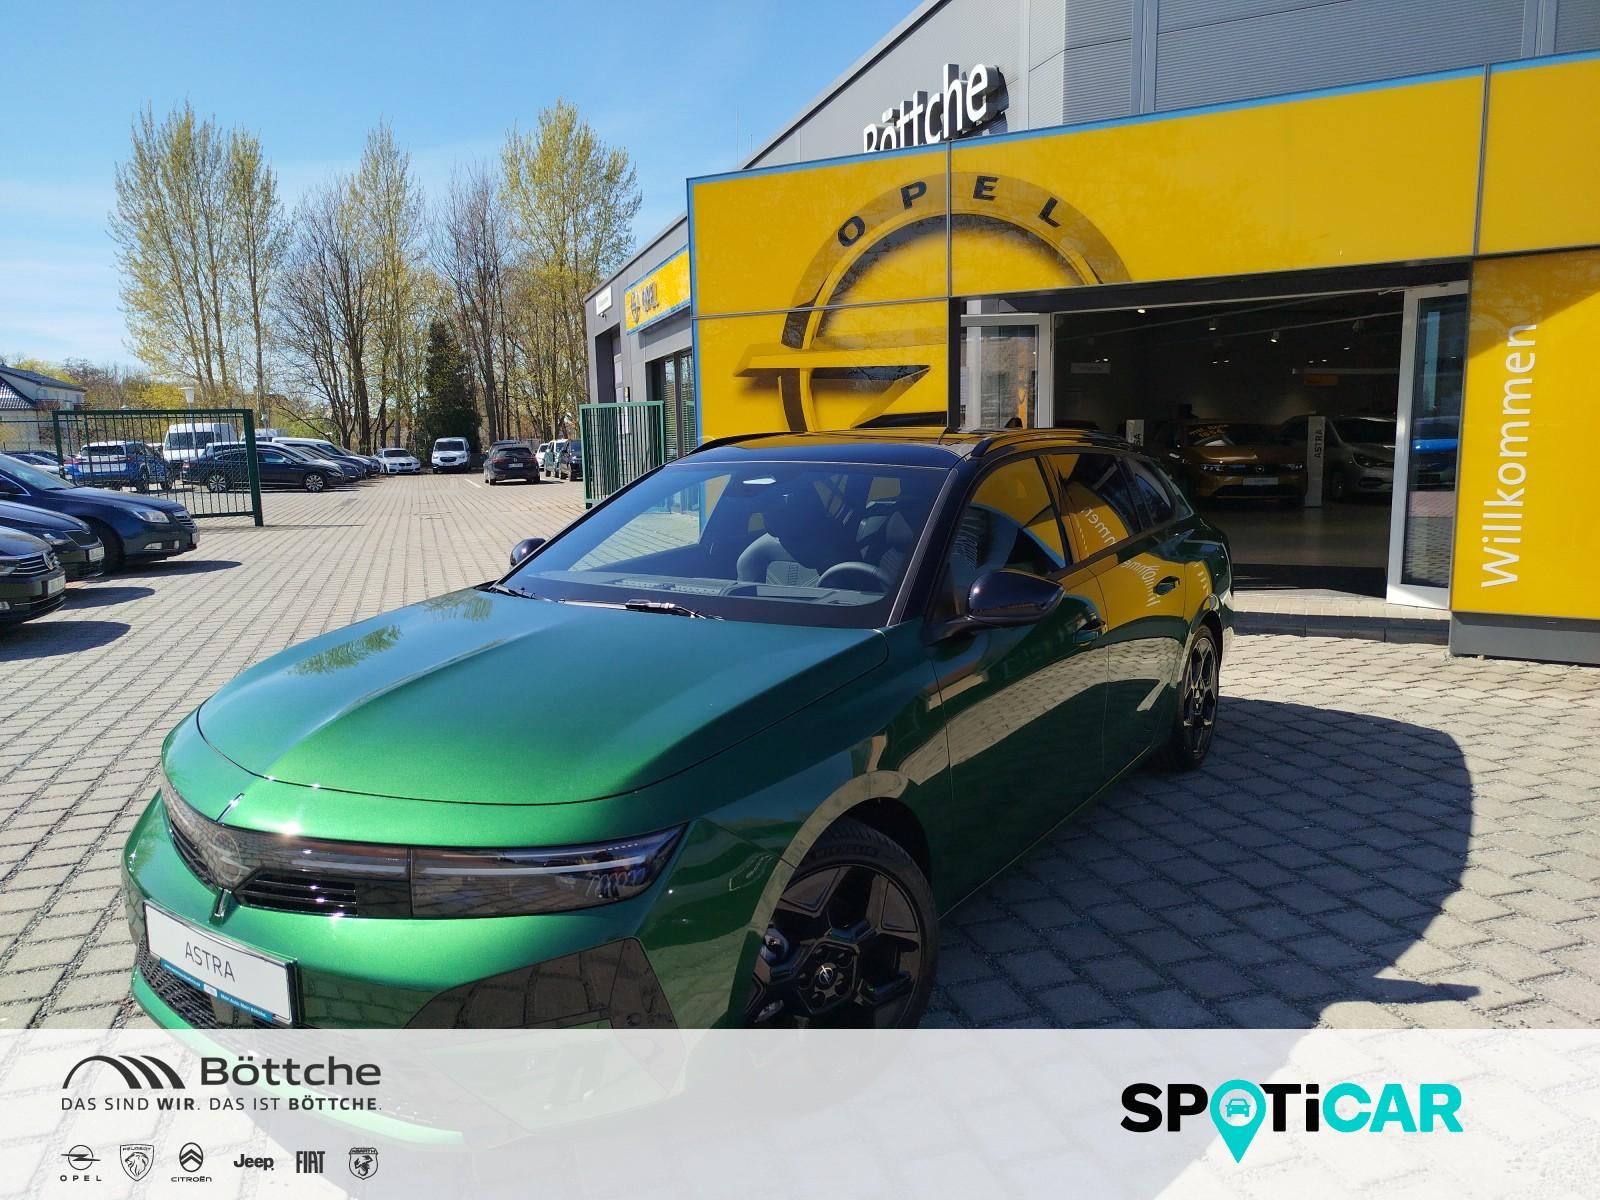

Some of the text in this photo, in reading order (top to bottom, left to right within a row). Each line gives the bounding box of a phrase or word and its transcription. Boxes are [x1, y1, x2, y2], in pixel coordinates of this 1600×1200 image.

[837, 175, 1062, 248] OPEL
[1480, 323, 1537, 589] Willkommen
[184, 941, 236, 983] ASTRA
